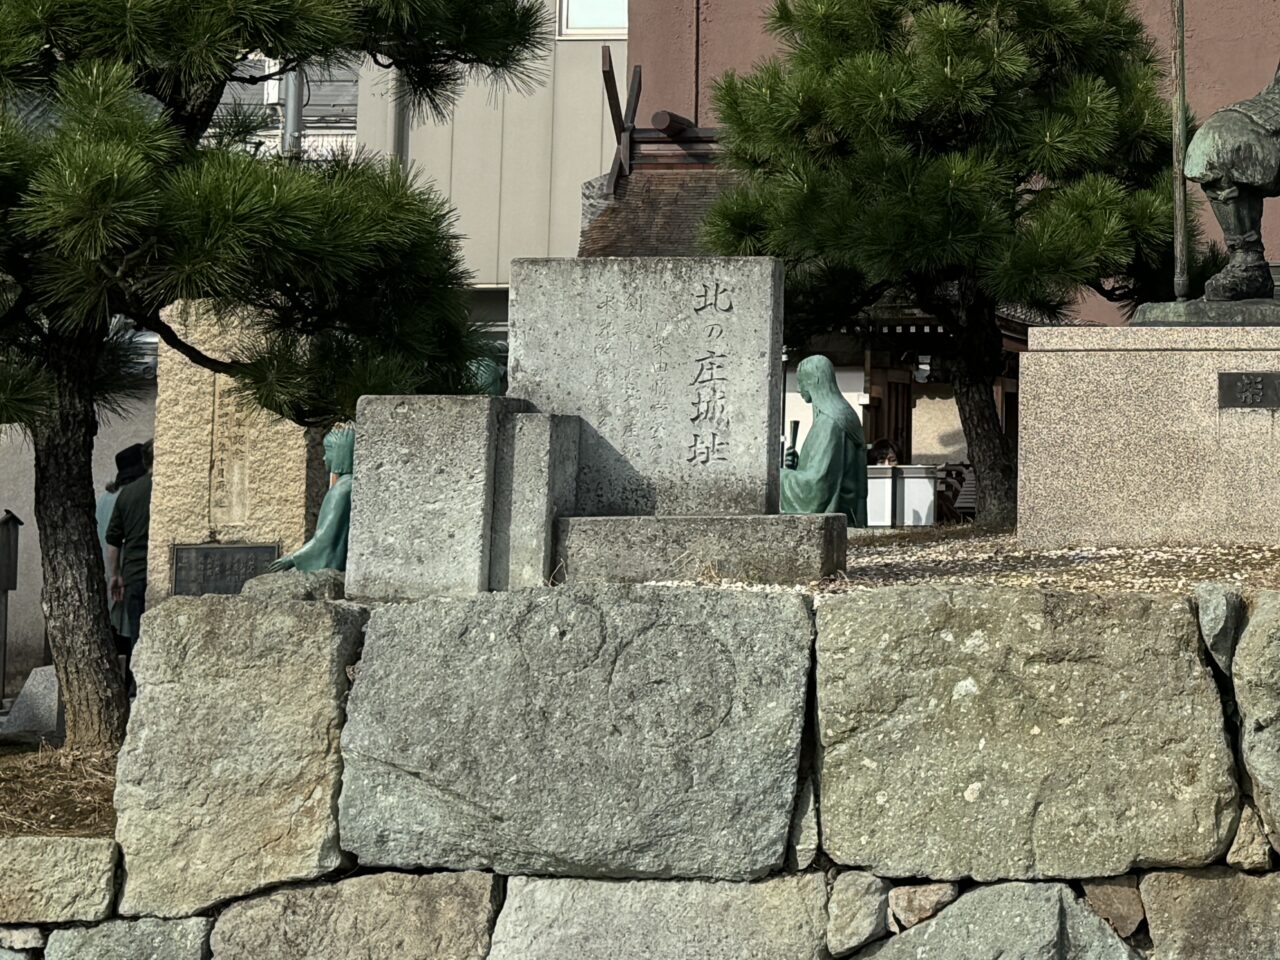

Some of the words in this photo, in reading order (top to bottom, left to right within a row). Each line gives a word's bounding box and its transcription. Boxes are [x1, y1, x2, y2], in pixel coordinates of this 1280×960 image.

[686, 281, 735, 465] 北の庄城址
